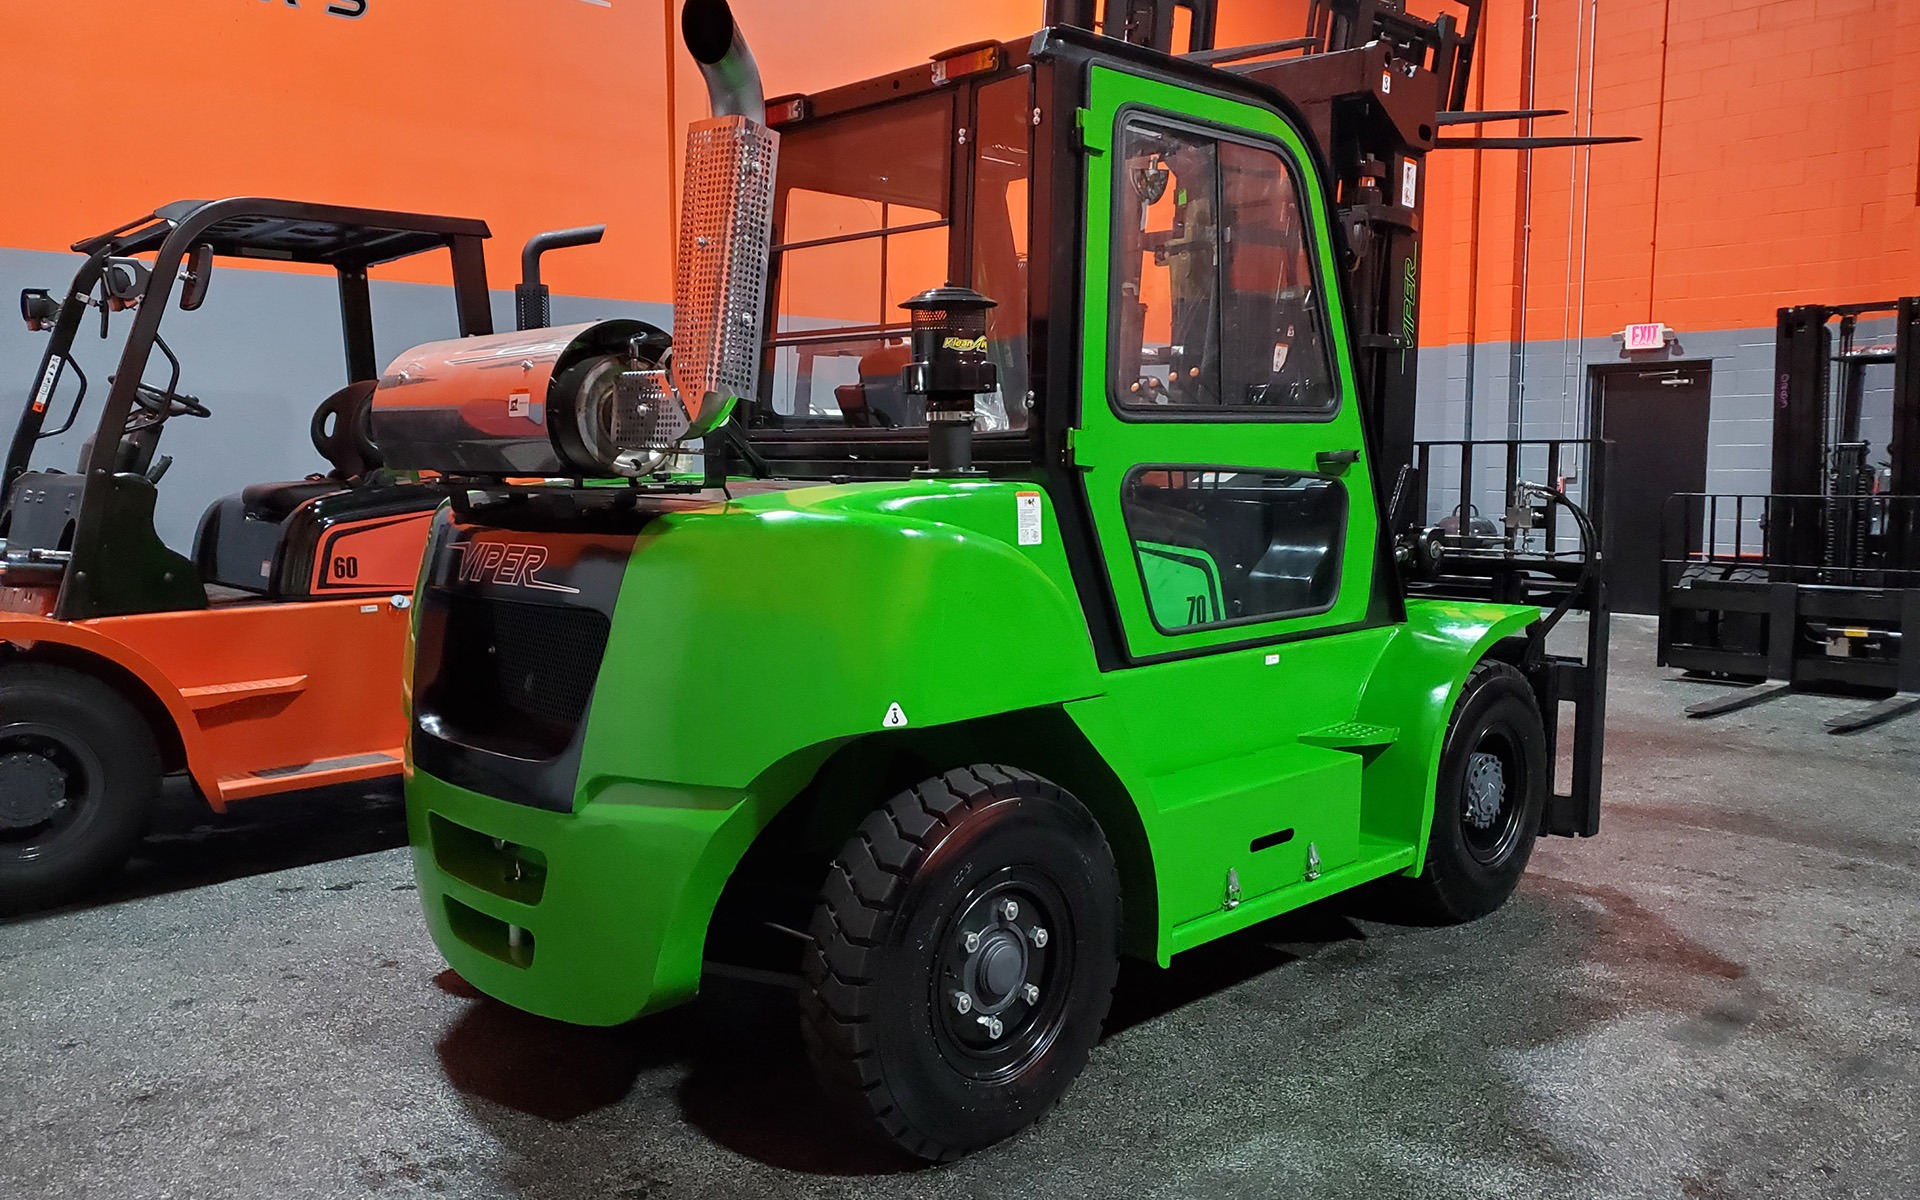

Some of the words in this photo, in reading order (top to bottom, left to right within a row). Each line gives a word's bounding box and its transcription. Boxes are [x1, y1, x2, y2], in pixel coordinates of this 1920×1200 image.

[1401, 241, 1418, 375] VIPER
[1631, 324, 1659, 346] EXIT
[333, 556, 358, 579] 60
[446, 541, 580, 594] VIPER
[1186, 594, 1206, 625] 70
